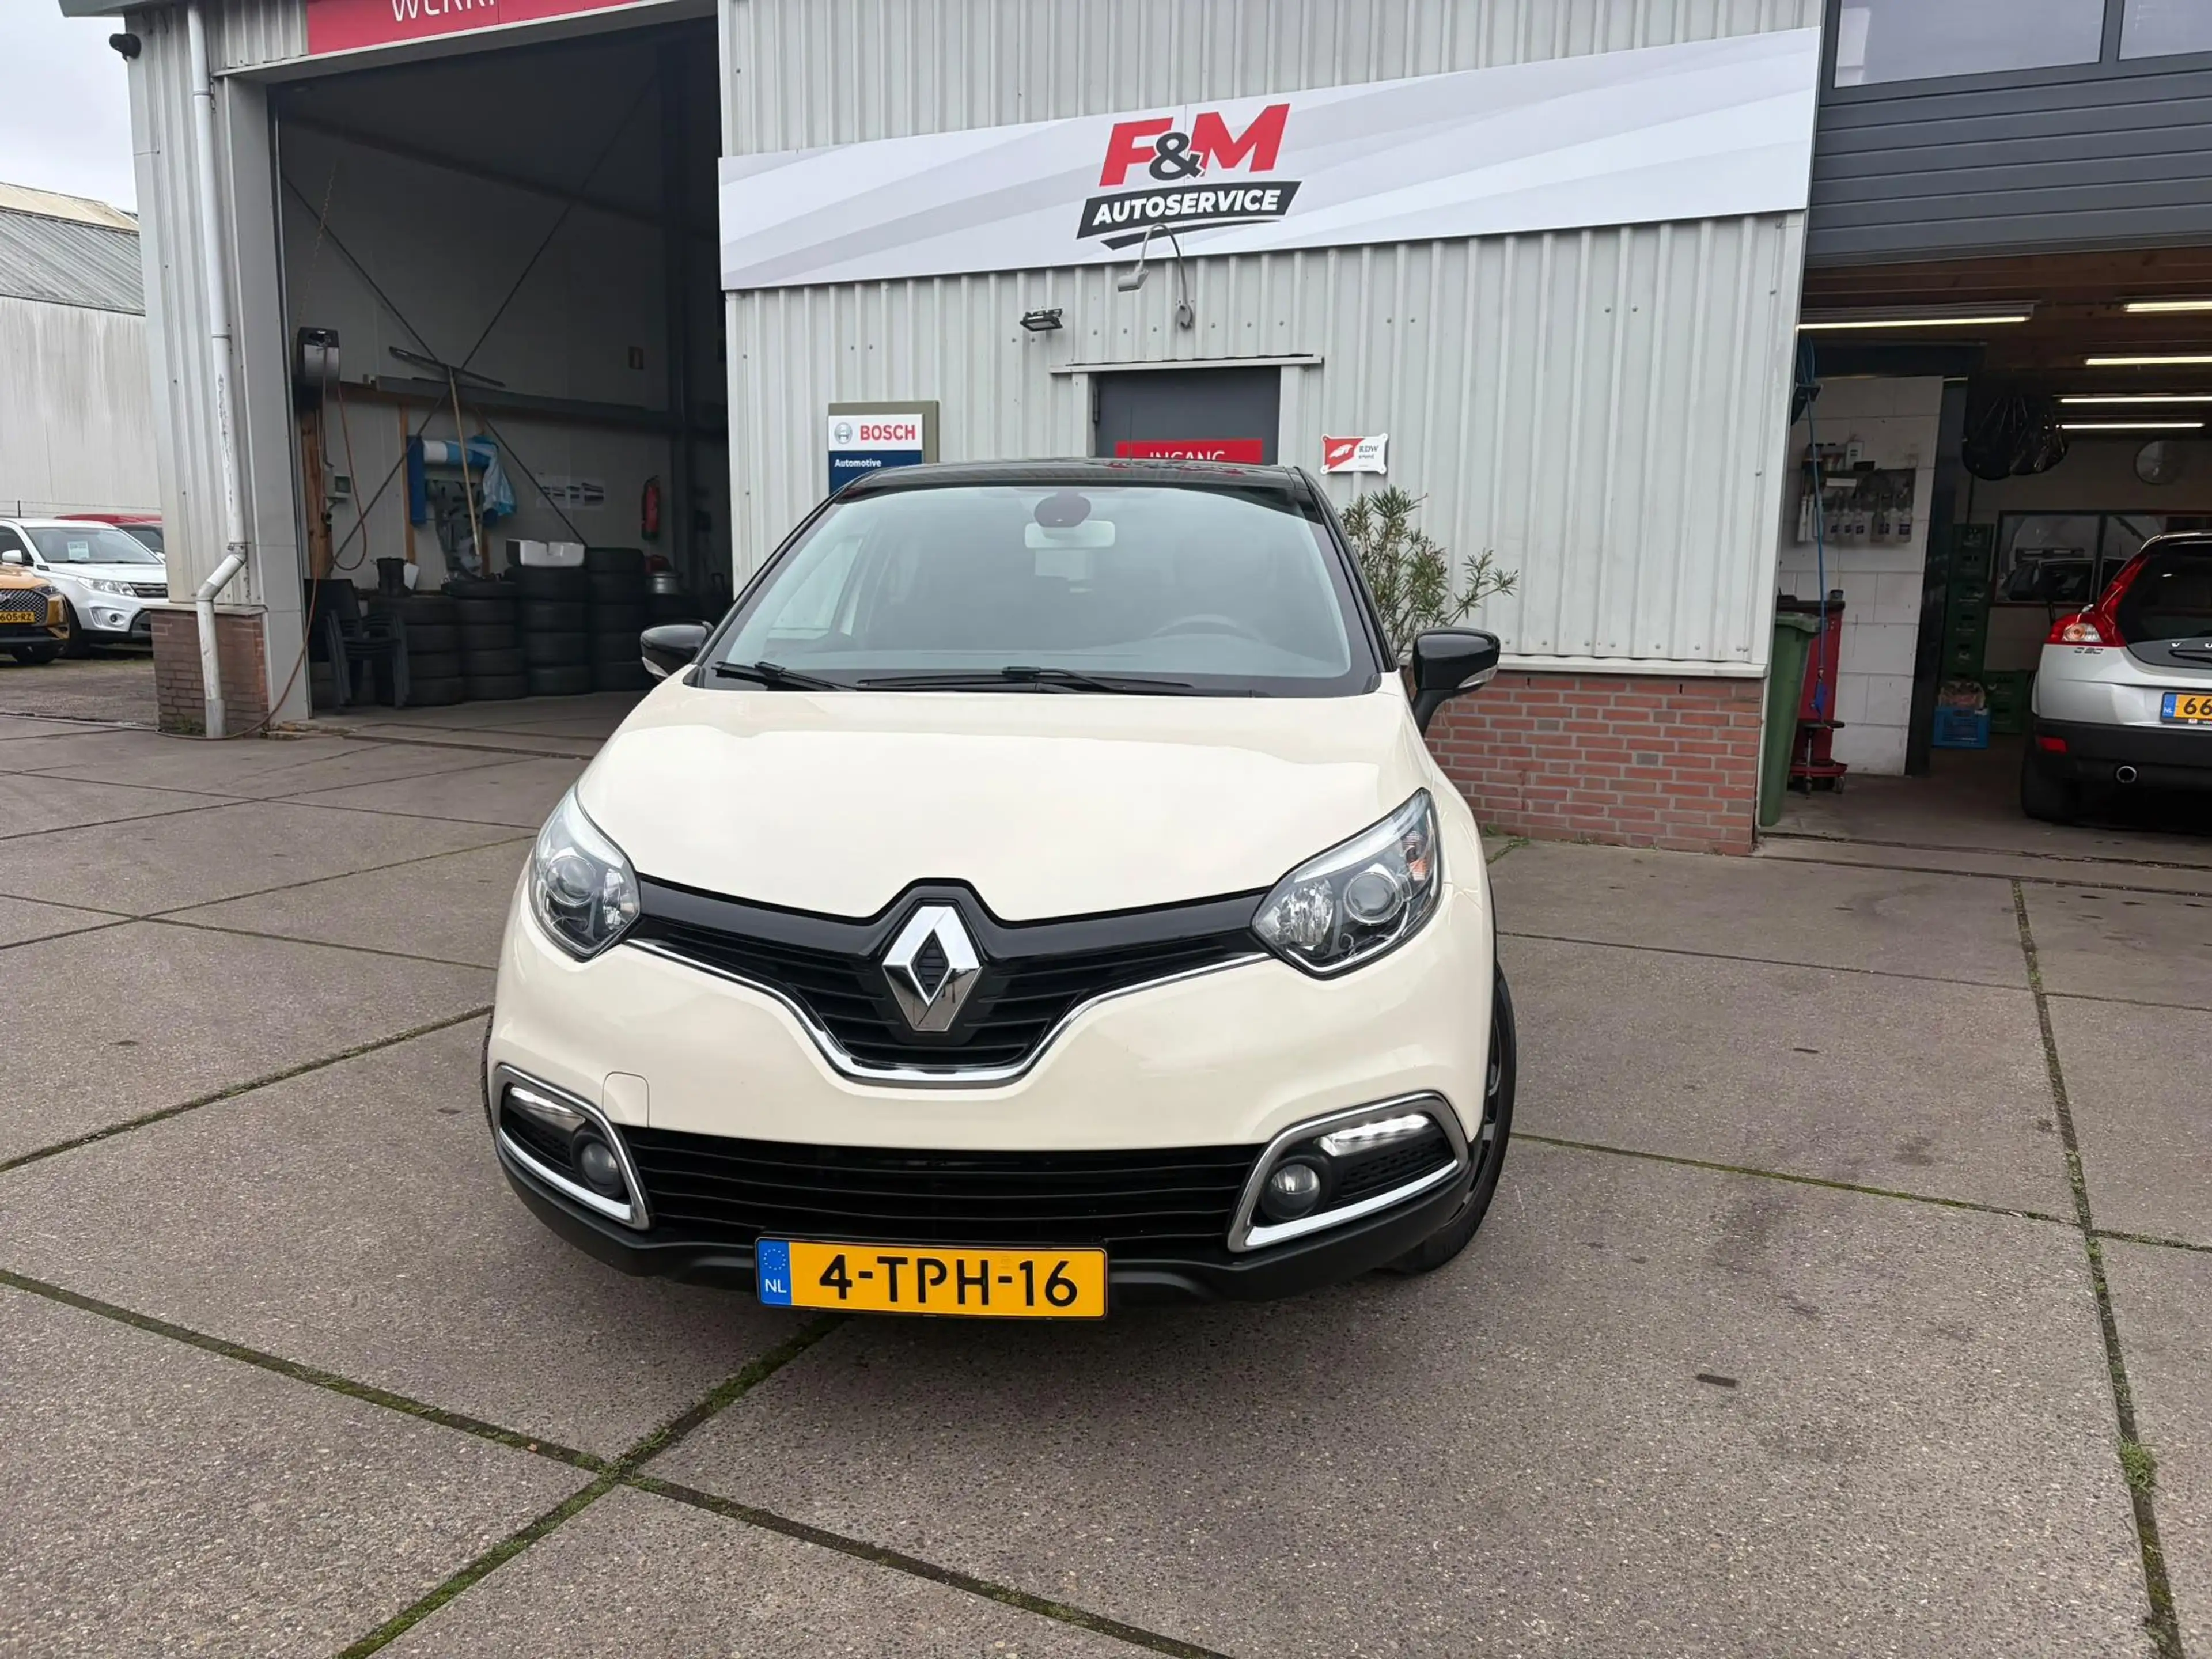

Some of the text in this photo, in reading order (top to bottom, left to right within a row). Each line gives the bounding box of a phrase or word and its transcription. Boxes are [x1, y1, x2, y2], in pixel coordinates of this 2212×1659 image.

[1099, 103, 1290, 187] F&M
[1093, 190, 1281, 226] AUTOSERVICE
[860, 425, 916, 441] BOSCH
[835, 458, 882, 468] Automotive
[765, 1278, 787, 1294] NL
[819, 1253, 1078, 1308] 4-TPH-16
